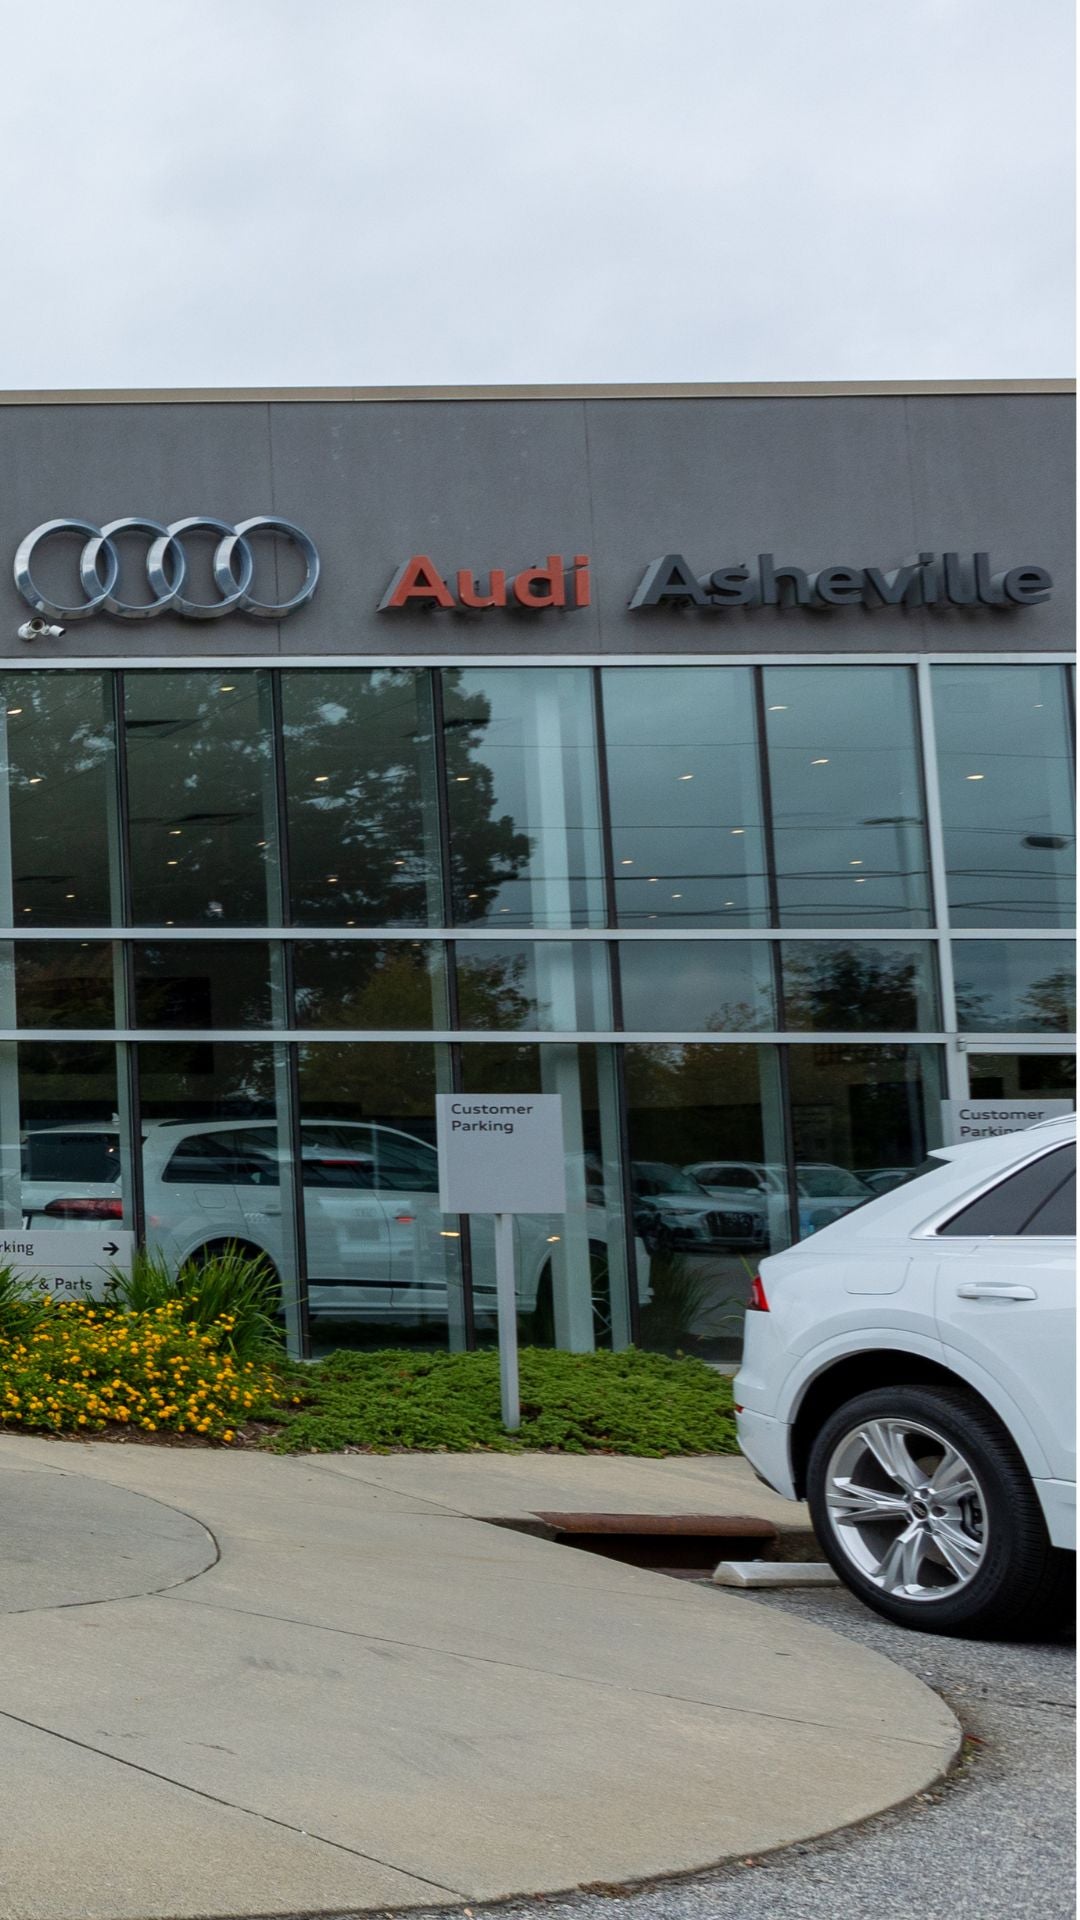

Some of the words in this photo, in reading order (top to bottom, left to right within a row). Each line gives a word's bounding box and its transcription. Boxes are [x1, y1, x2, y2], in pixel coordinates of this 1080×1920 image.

[380, 553, 591, 609] Audi
[632, 551, 1055, 608] Asheville
[451, 1103, 534, 1115] Customer
[959, 1109, 1045, 1121] Customer
[451, 1120, 514, 1134] Parking
[960, 1126, 1024, 1138] Parkin
[38, 1277, 50, 1290] &
[55, 1277, 93, 1290] Parts
